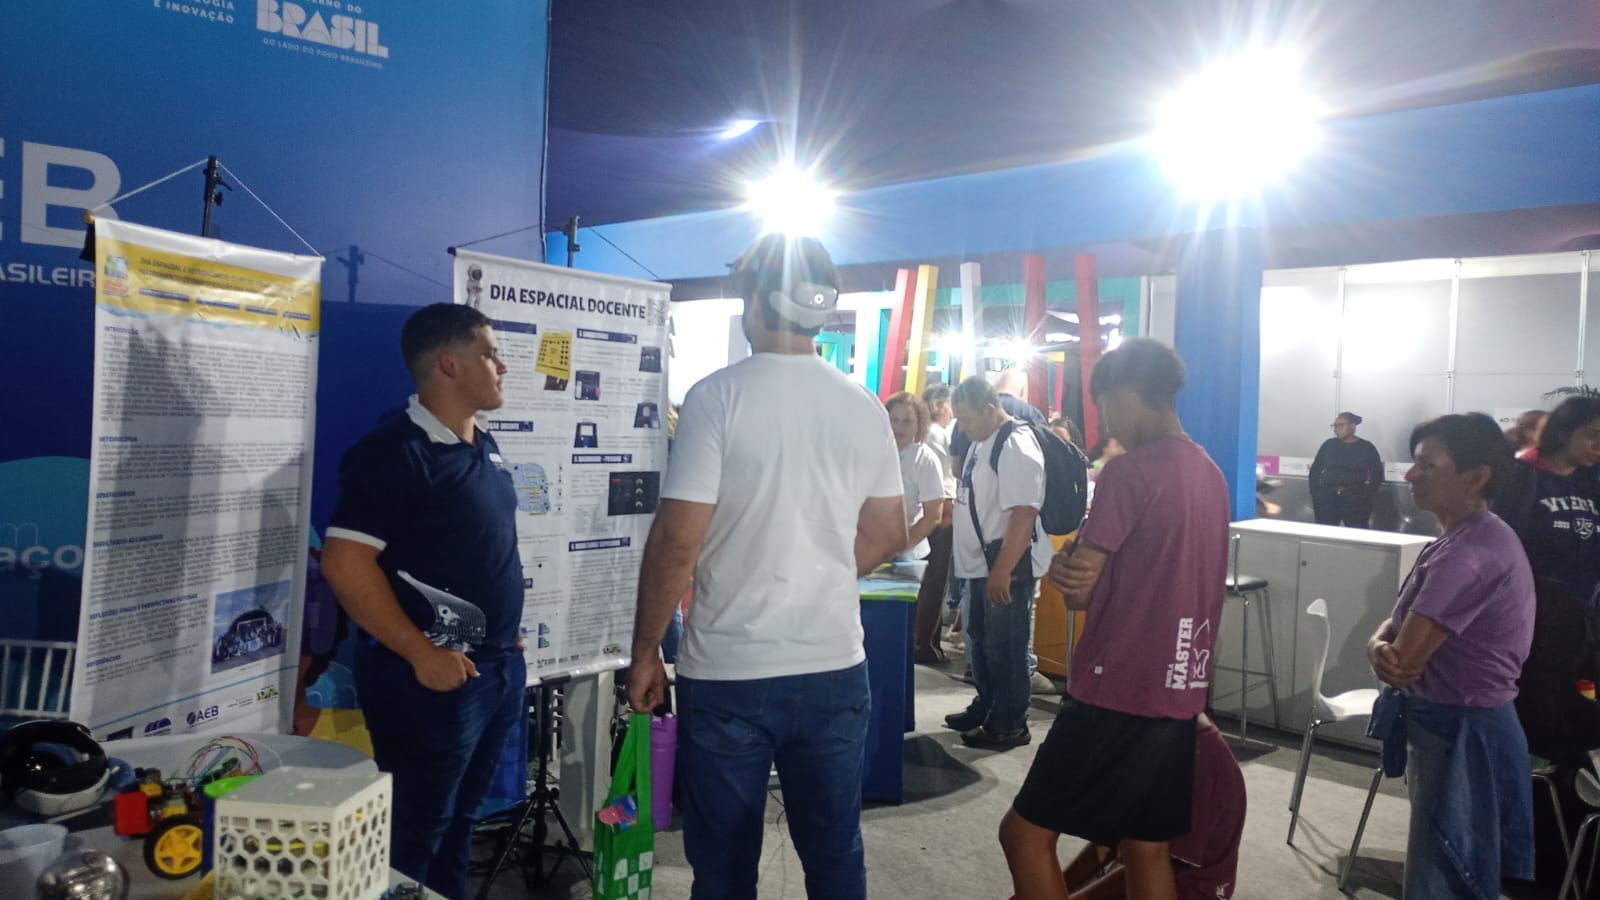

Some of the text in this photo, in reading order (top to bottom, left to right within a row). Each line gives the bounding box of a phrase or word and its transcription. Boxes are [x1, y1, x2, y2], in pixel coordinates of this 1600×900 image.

[166, 1, 234, 24] INOVAÇÃO
[347, 4, 361, 14] DO
[256, 0, 388, 58] BRASIL
[0, 137, 121, 250] B
[490, 284, 646, 319] DIA ESPACIAL DOCENTE
[1171, 618, 1194, 689] MASTER
[197, 704, 219, 722] AEB
